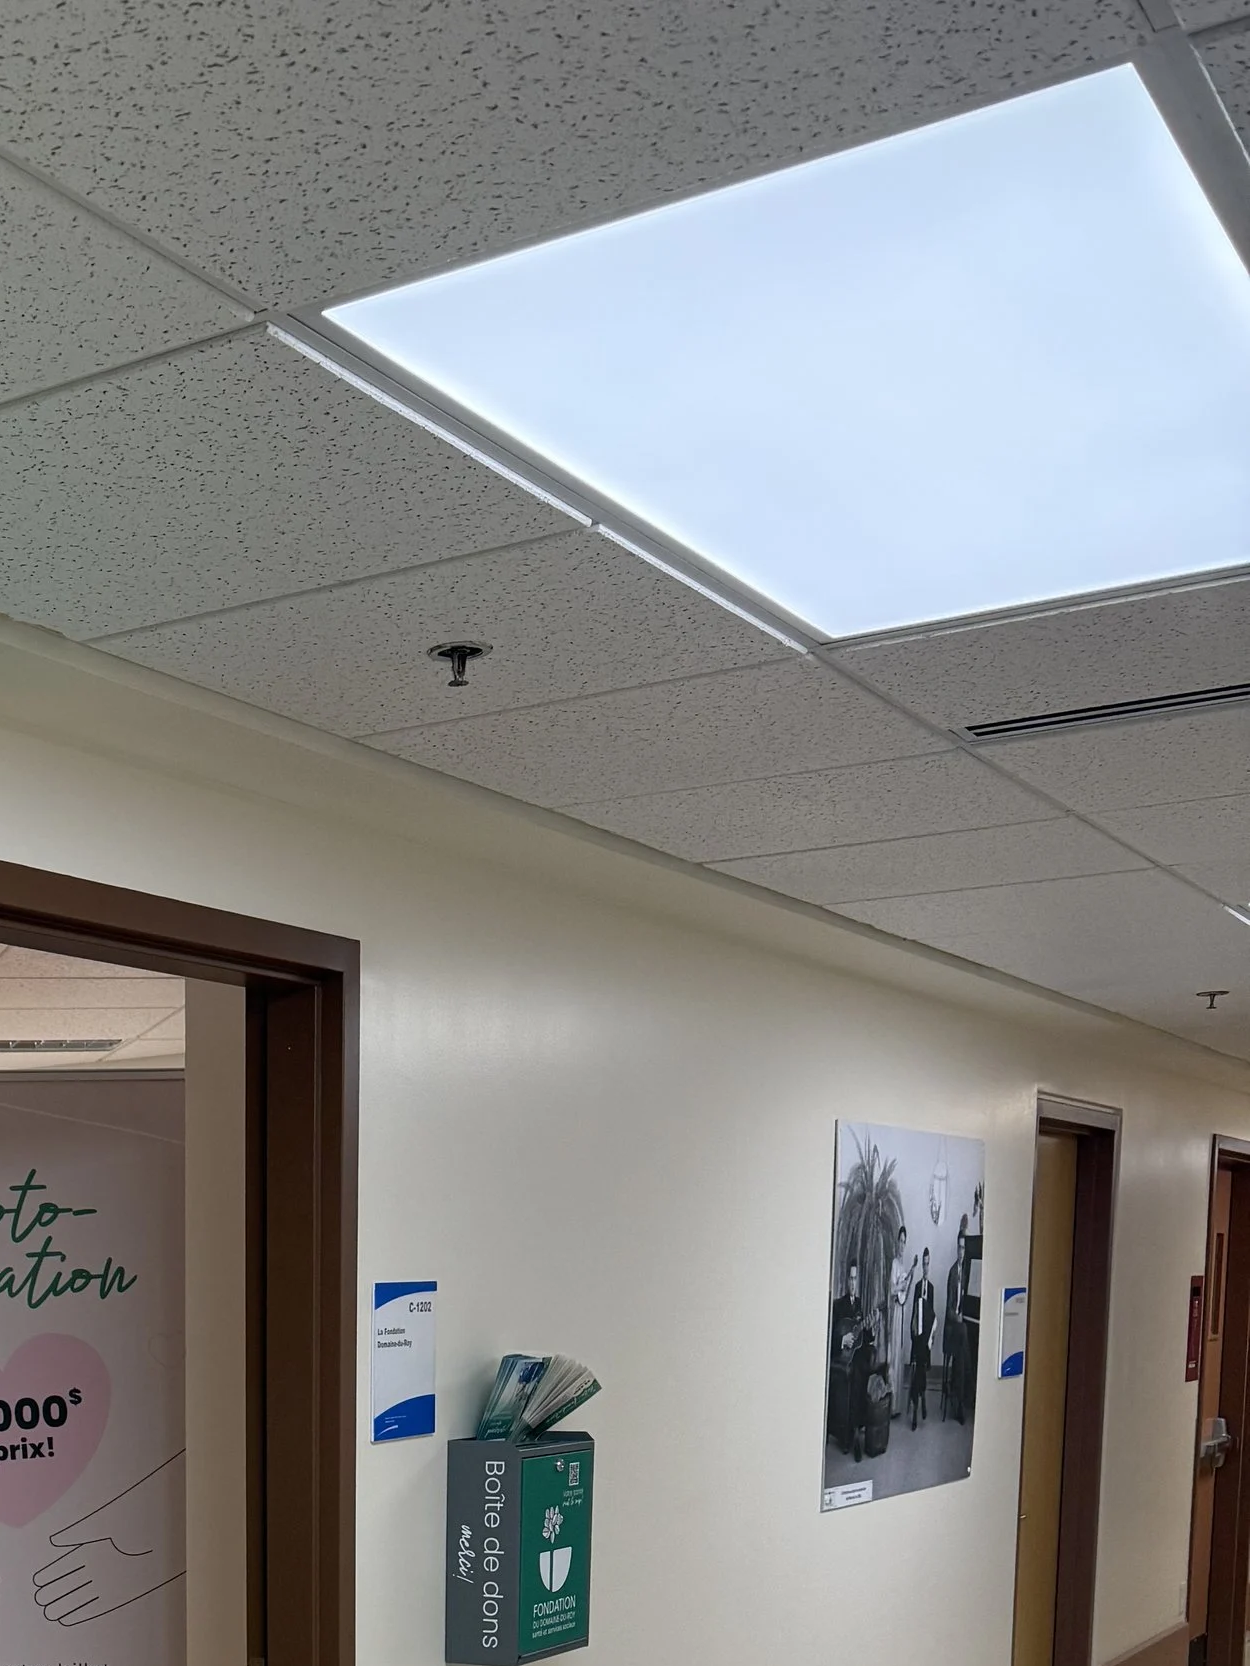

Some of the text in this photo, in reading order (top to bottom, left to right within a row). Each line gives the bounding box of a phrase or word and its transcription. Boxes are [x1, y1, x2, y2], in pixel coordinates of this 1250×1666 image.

[408, 1301, 432, 1313] C-1202
[484, 1461, 506, 1528] Boîte
[453, 1524, 476, 1584] merci!
[483, 1537, 505, 1573] de
[482, 1581, 504, 1649] dons
[533, 1594, 577, 1618] FONDATION
